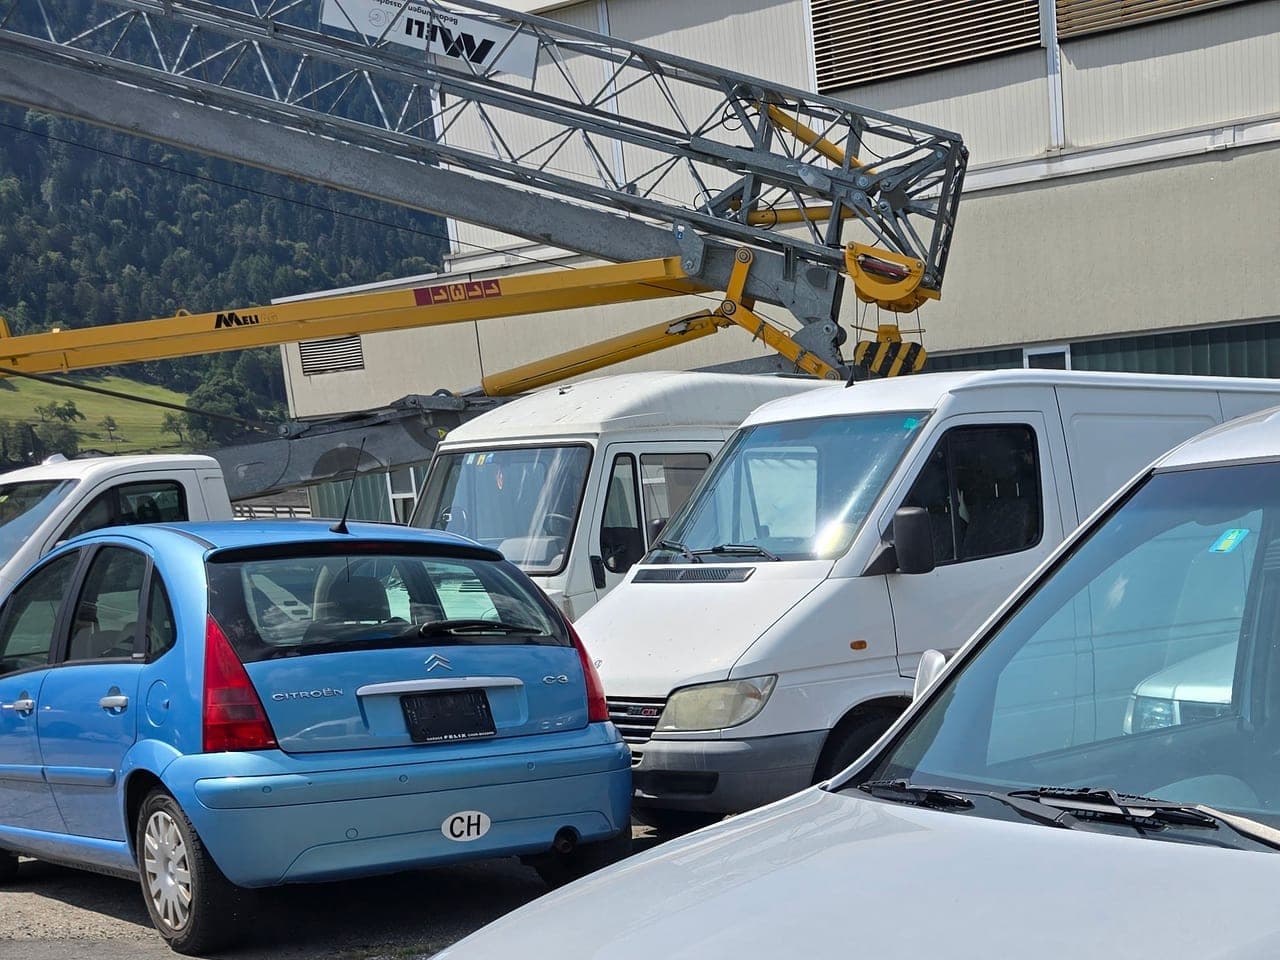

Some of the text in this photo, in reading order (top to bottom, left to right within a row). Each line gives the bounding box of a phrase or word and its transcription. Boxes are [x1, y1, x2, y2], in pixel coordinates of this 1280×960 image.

[408, 5, 458, 26] Bedaungen
[405, 17, 496, 65] MELI
[214, 312, 260, 329] MELI
[542, 674, 569, 684] C3
[272, 688, 344, 701] CITROËN
[450, 814, 481, 838] CH
